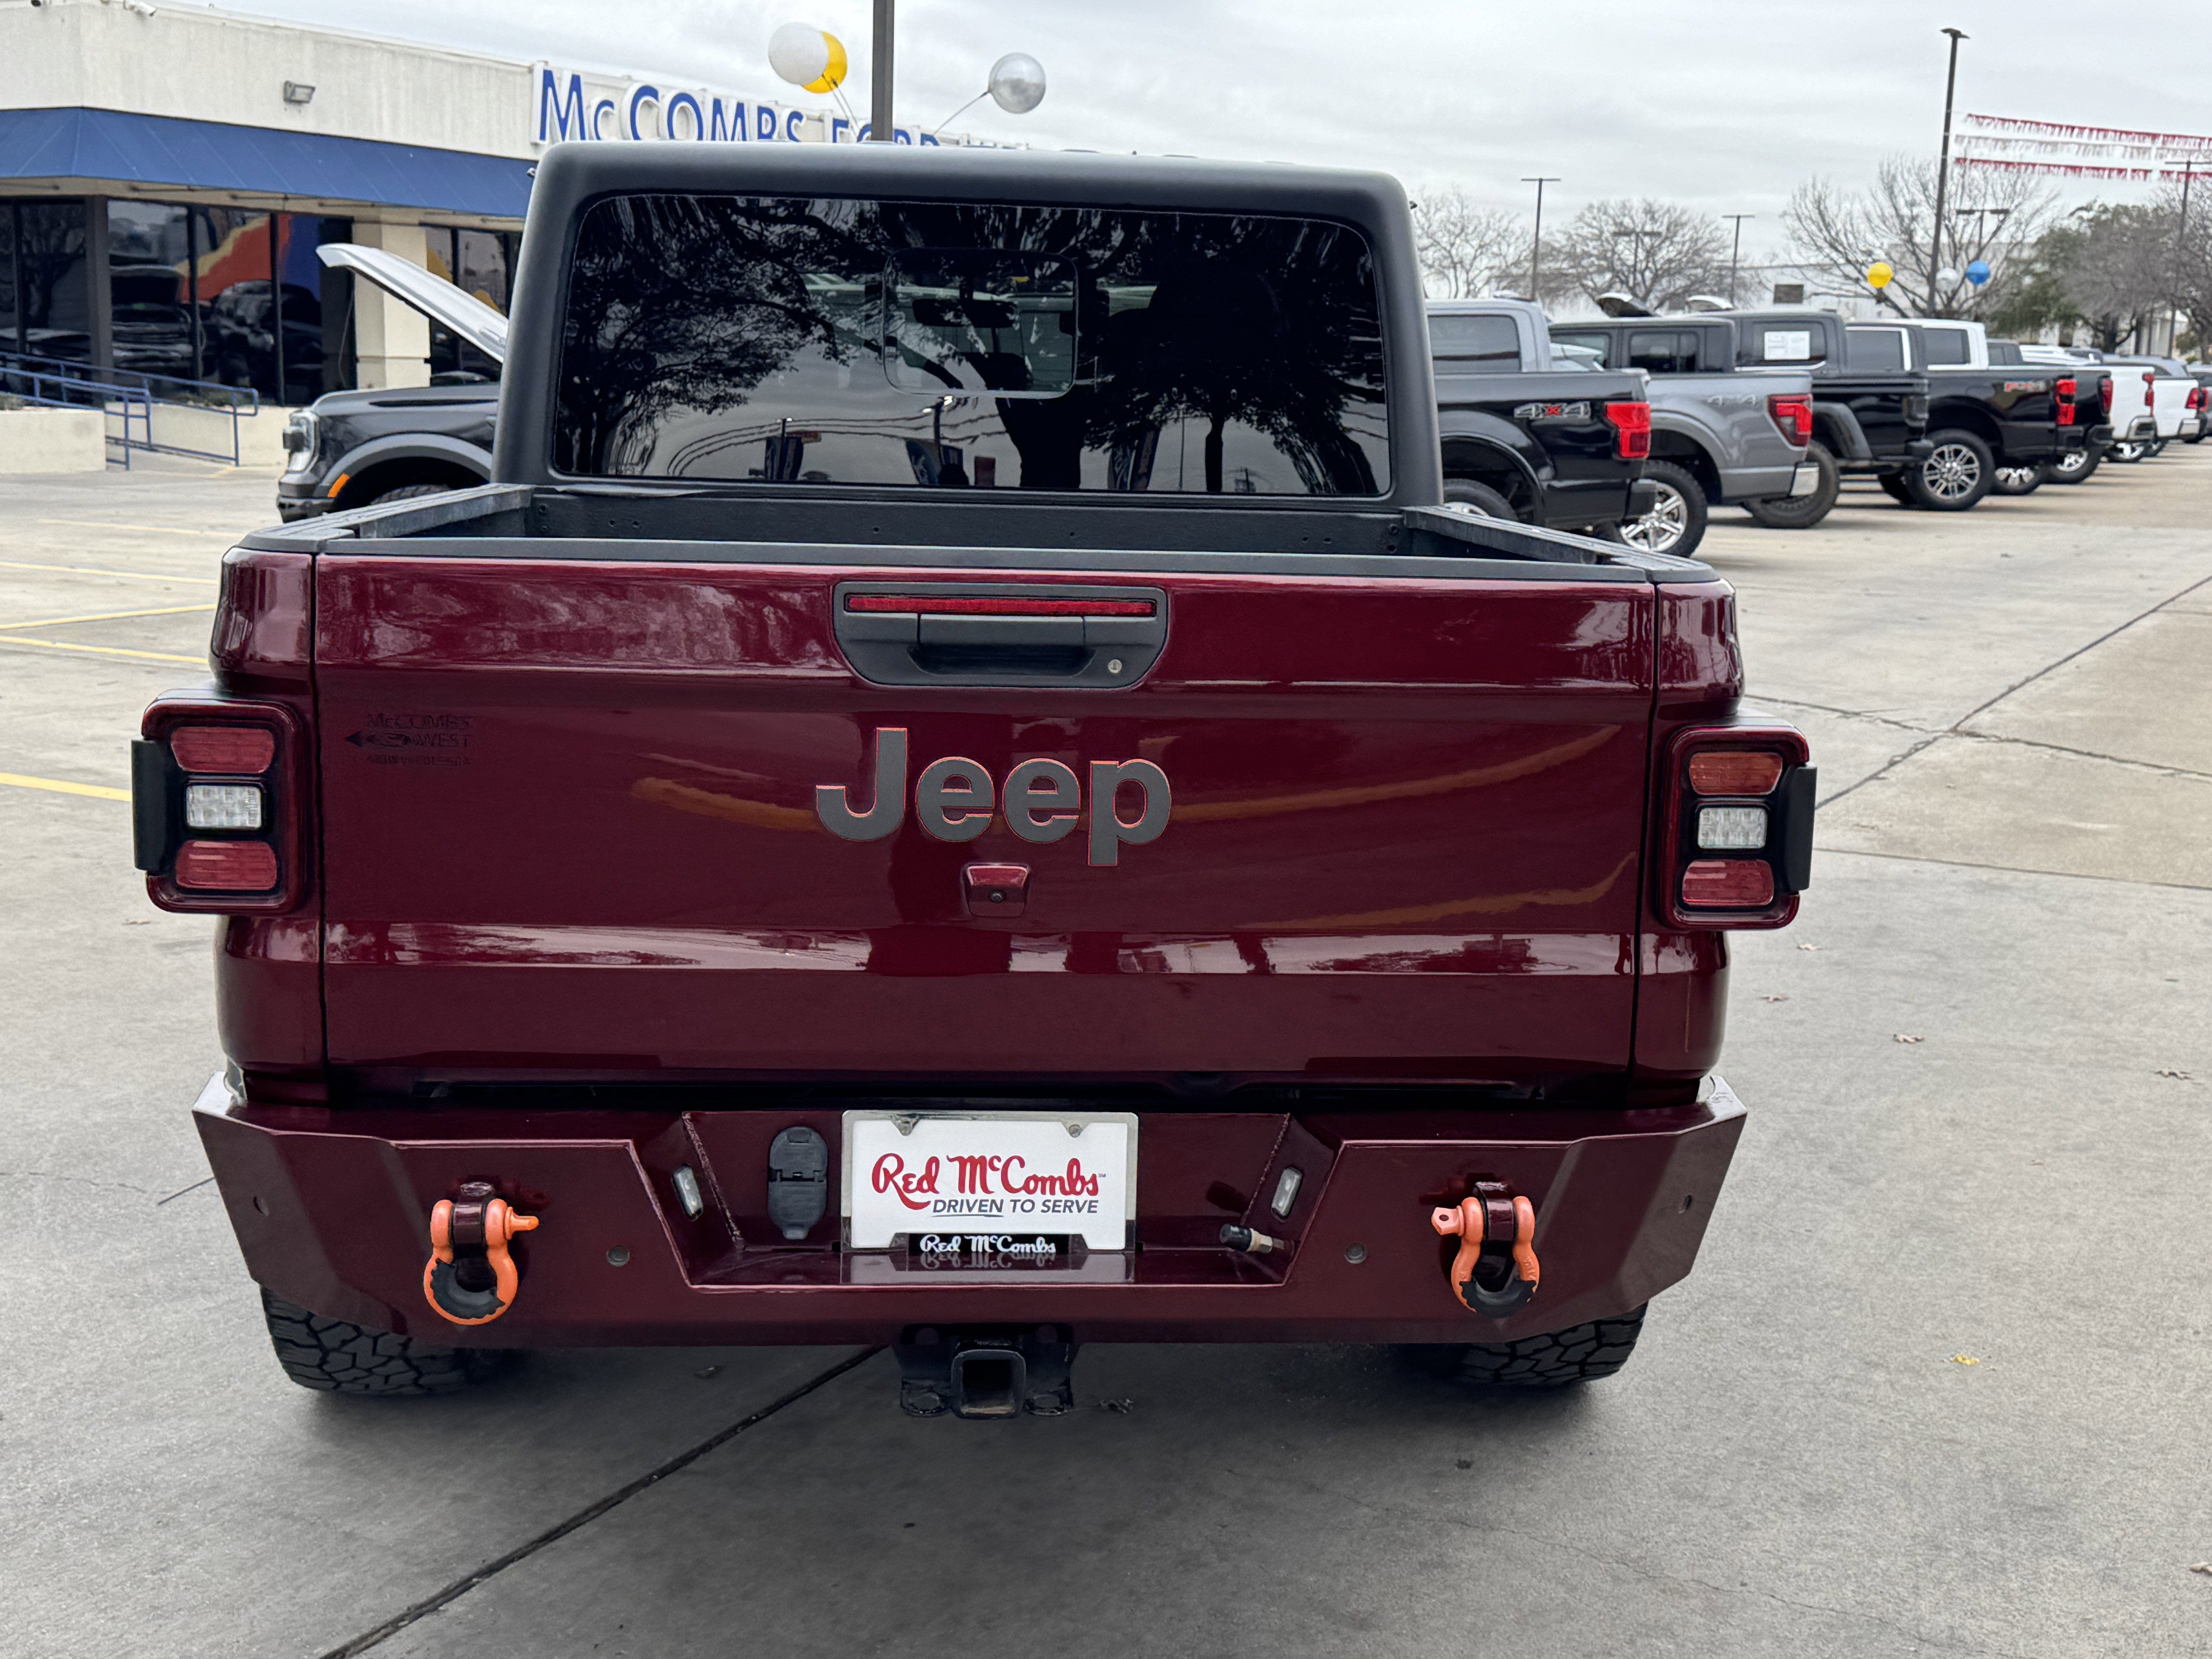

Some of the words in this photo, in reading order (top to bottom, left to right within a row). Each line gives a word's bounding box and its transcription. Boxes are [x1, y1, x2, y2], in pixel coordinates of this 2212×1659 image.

[816, 727, 1172, 867] Jeep
[871, 1152, 940, 1211] Red
[933, 1199, 1004, 1214] DRIVEN
[1010, 1199, 1035, 1213] TO
[1041, 1199, 1099, 1214] SERVE
[920, 1234, 962, 1253] Red
[964, 1235, 1056, 1254] McCombs
